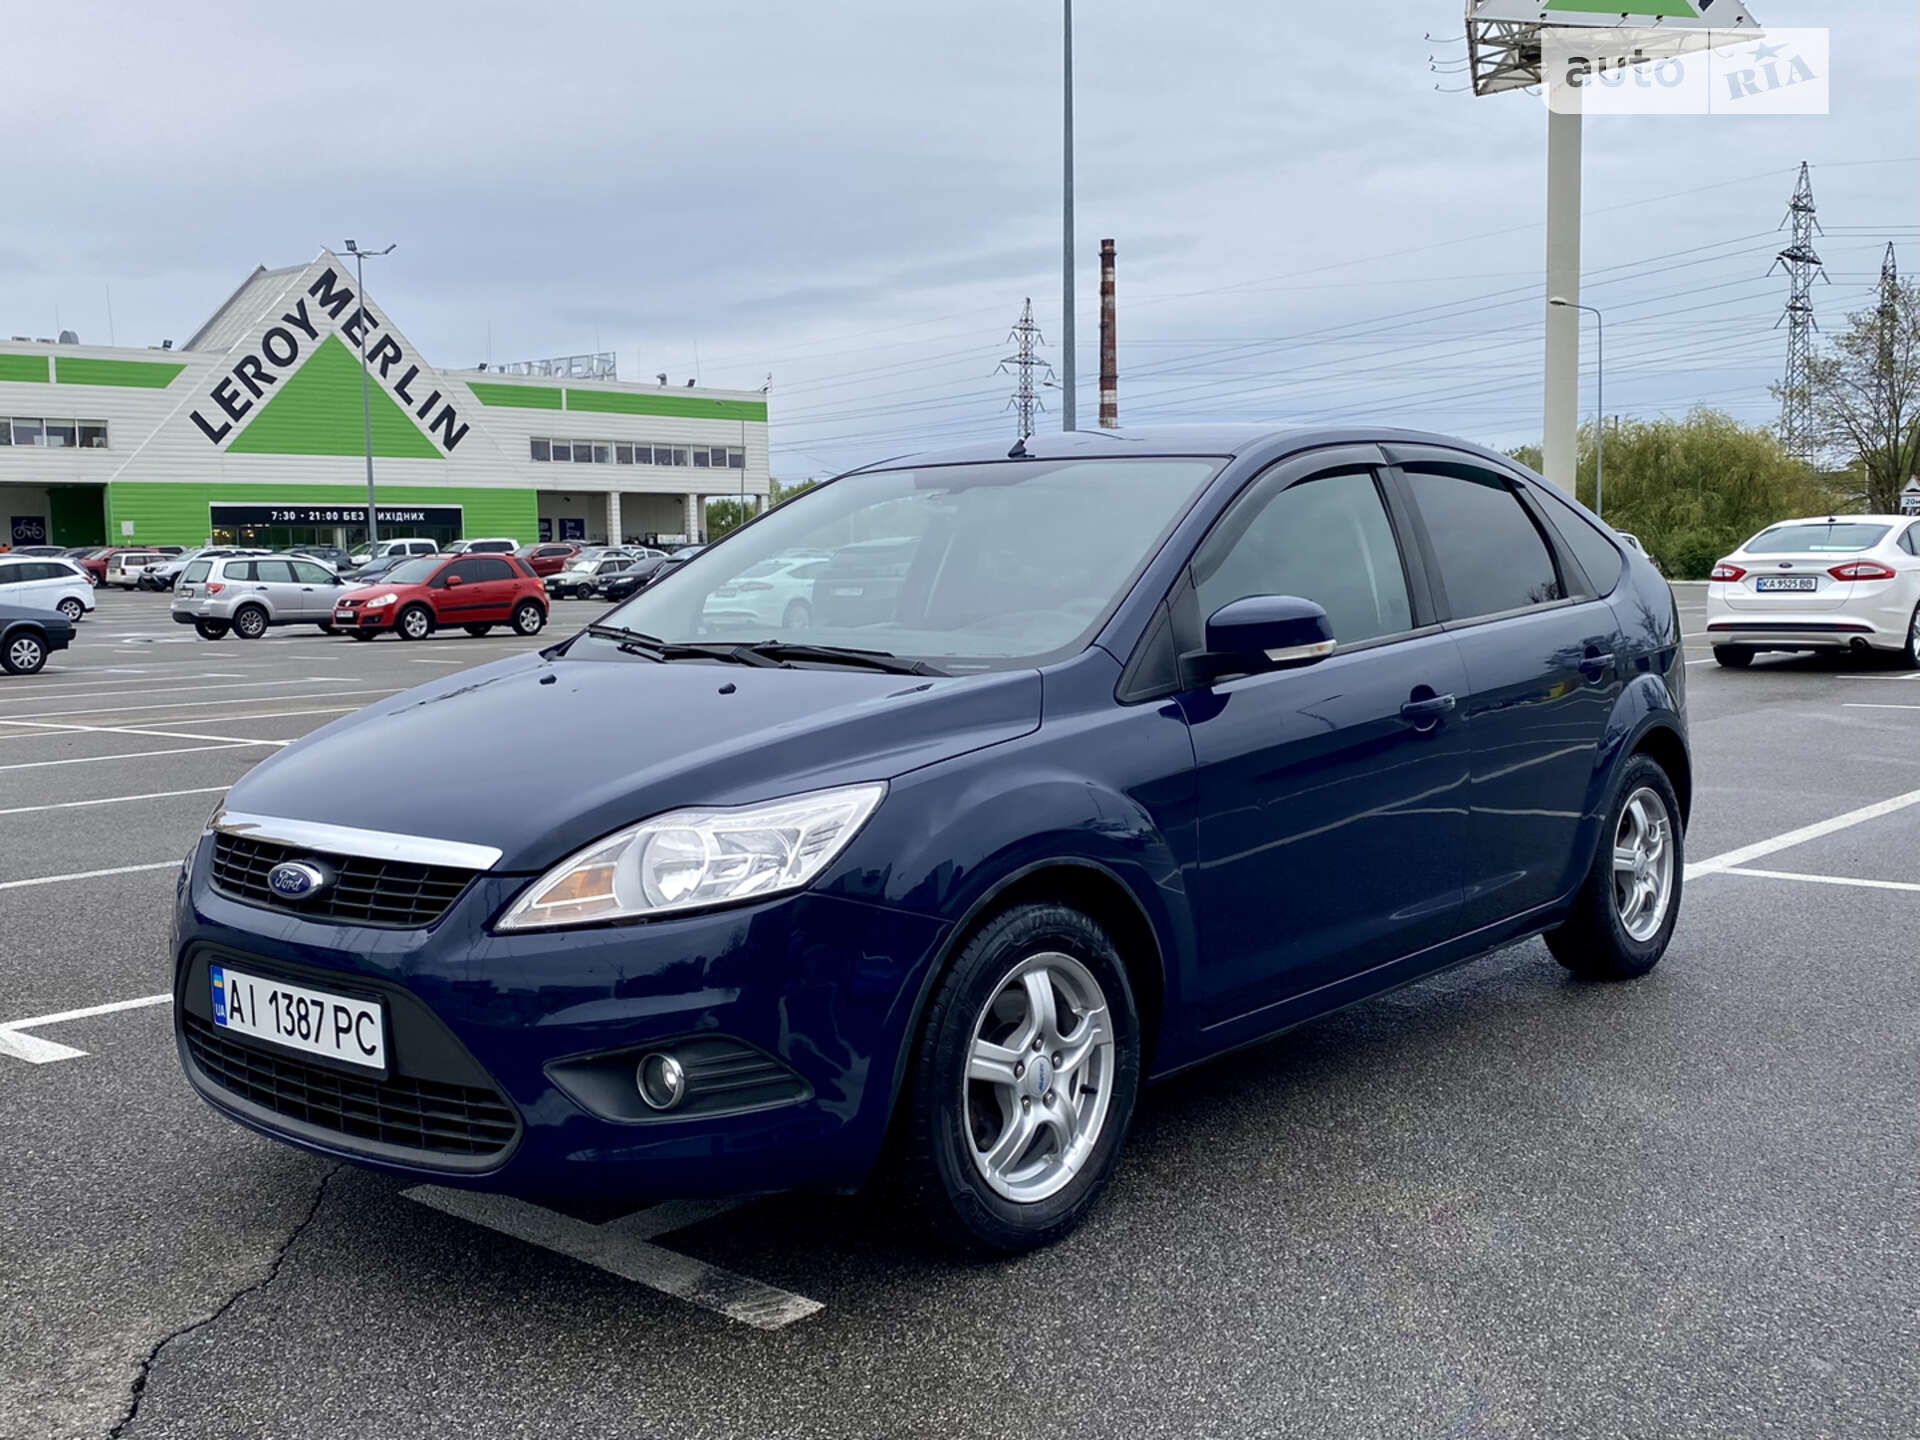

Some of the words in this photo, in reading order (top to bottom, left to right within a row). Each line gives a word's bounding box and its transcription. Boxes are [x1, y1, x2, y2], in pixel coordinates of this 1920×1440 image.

[189, 297, 319, 445] LEROY
[307, 267, 470, 452] MERLIN
[271, 511, 296, 520] 7:30
[308, 511, 339, 521] 21:00
[343, 511, 365, 521] БЕЗ
[370, 511, 425, 522] ИХІДНИХ
[274, 869, 304, 892] Ford
[229, 979, 257, 1027] AI
[268, 989, 325, 1044] 1387
[333, 1004, 377, 1057] PC
